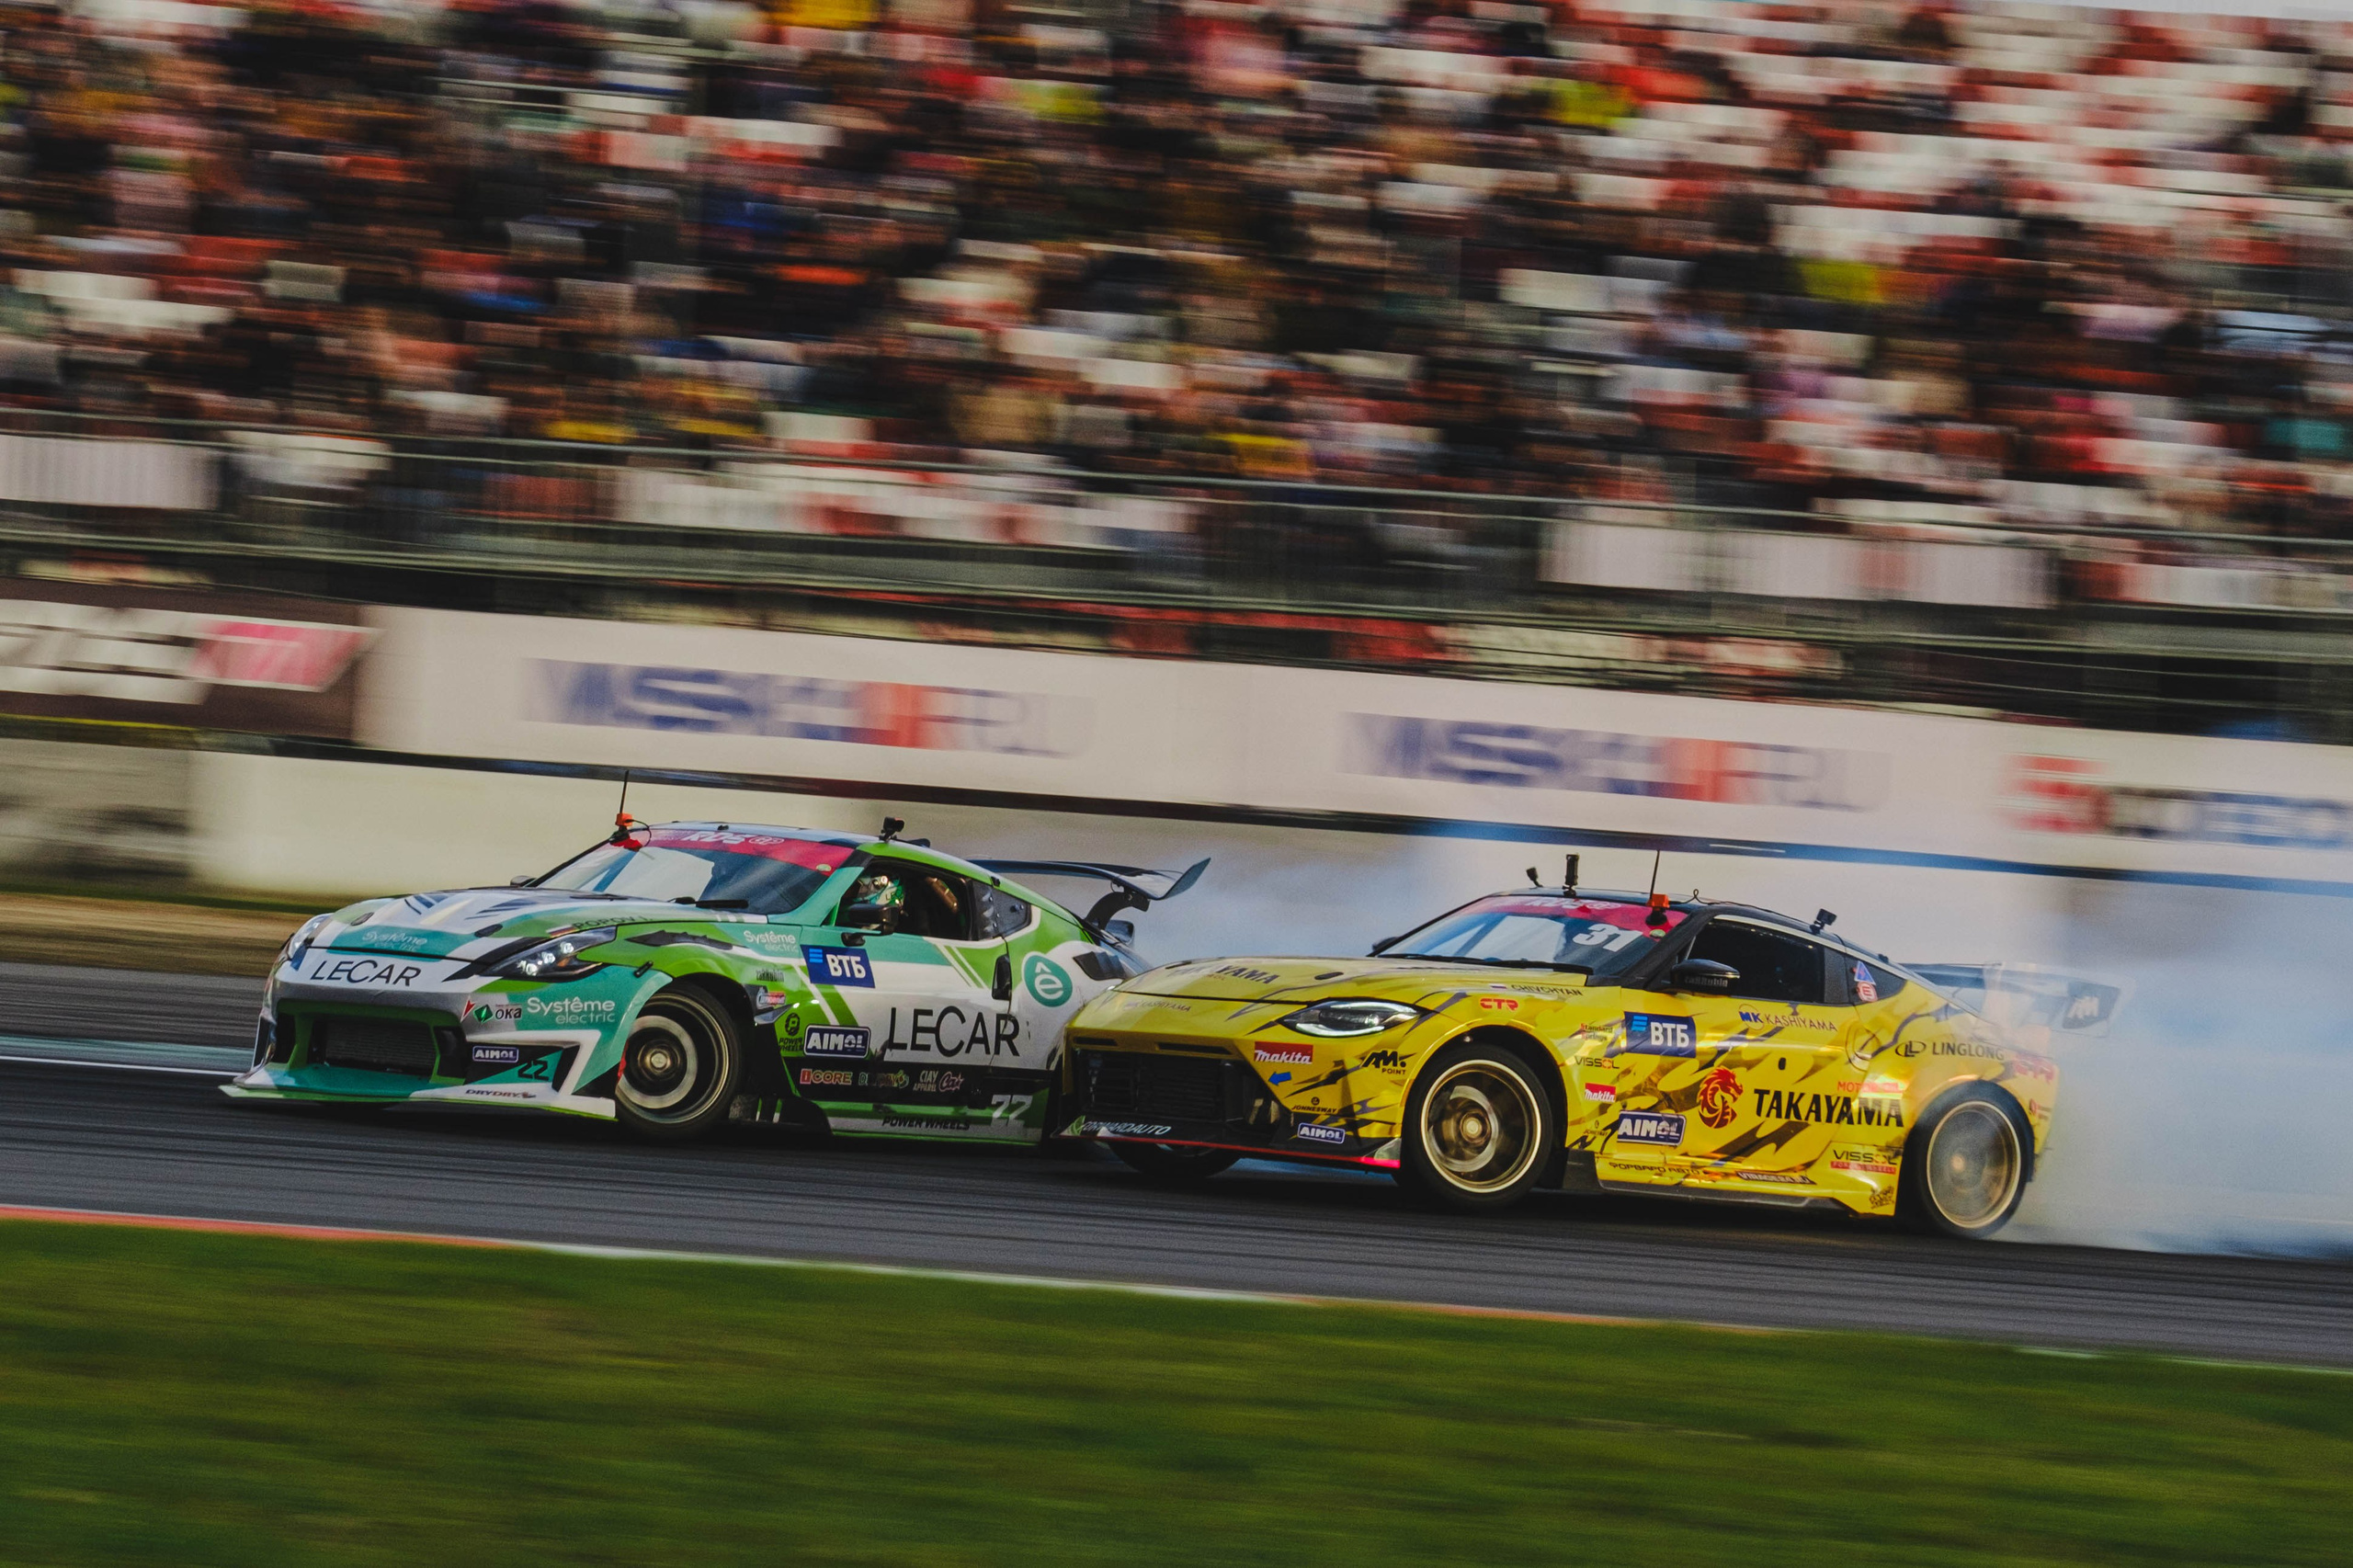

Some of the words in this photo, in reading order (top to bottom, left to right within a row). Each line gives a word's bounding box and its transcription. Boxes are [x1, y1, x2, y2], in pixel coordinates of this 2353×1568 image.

[743, 929, 796, 945] Systême
[1573, 924, 1643, 952] 31
[310, 960, 422, 987] LECAR
[826, 954, 867, 979] ВТБ
[527, 996, 615, 1016] Systême
[1480, 998, 1518, 1010] CTR
[555, 1012, 615, 1025] electric
[1765, 1014, 1837, 1031] KASHIYAMA
[887, 1006, 1020, 1057] LECAR
[1650, 1021, 1689, 1048] ВТБ
[807, 1032, 866, 1051] AIMOL
[474, 1049, 515, 1060] AIMOL
[1932, 1042, 2004, 1060] LINGLONG
[517, 1060, 549, 1081] 22
[1574, 1056, 1620, 1069] VISSOL
[1754, 1089, 1904, 1128] TAKAYAMA
[1300, 1126, 1342, 1141] AIMOL
[1618, 1119, 1680, 1137] AIMOL
[1833, 1149, 1897, 1165] VISSOL
